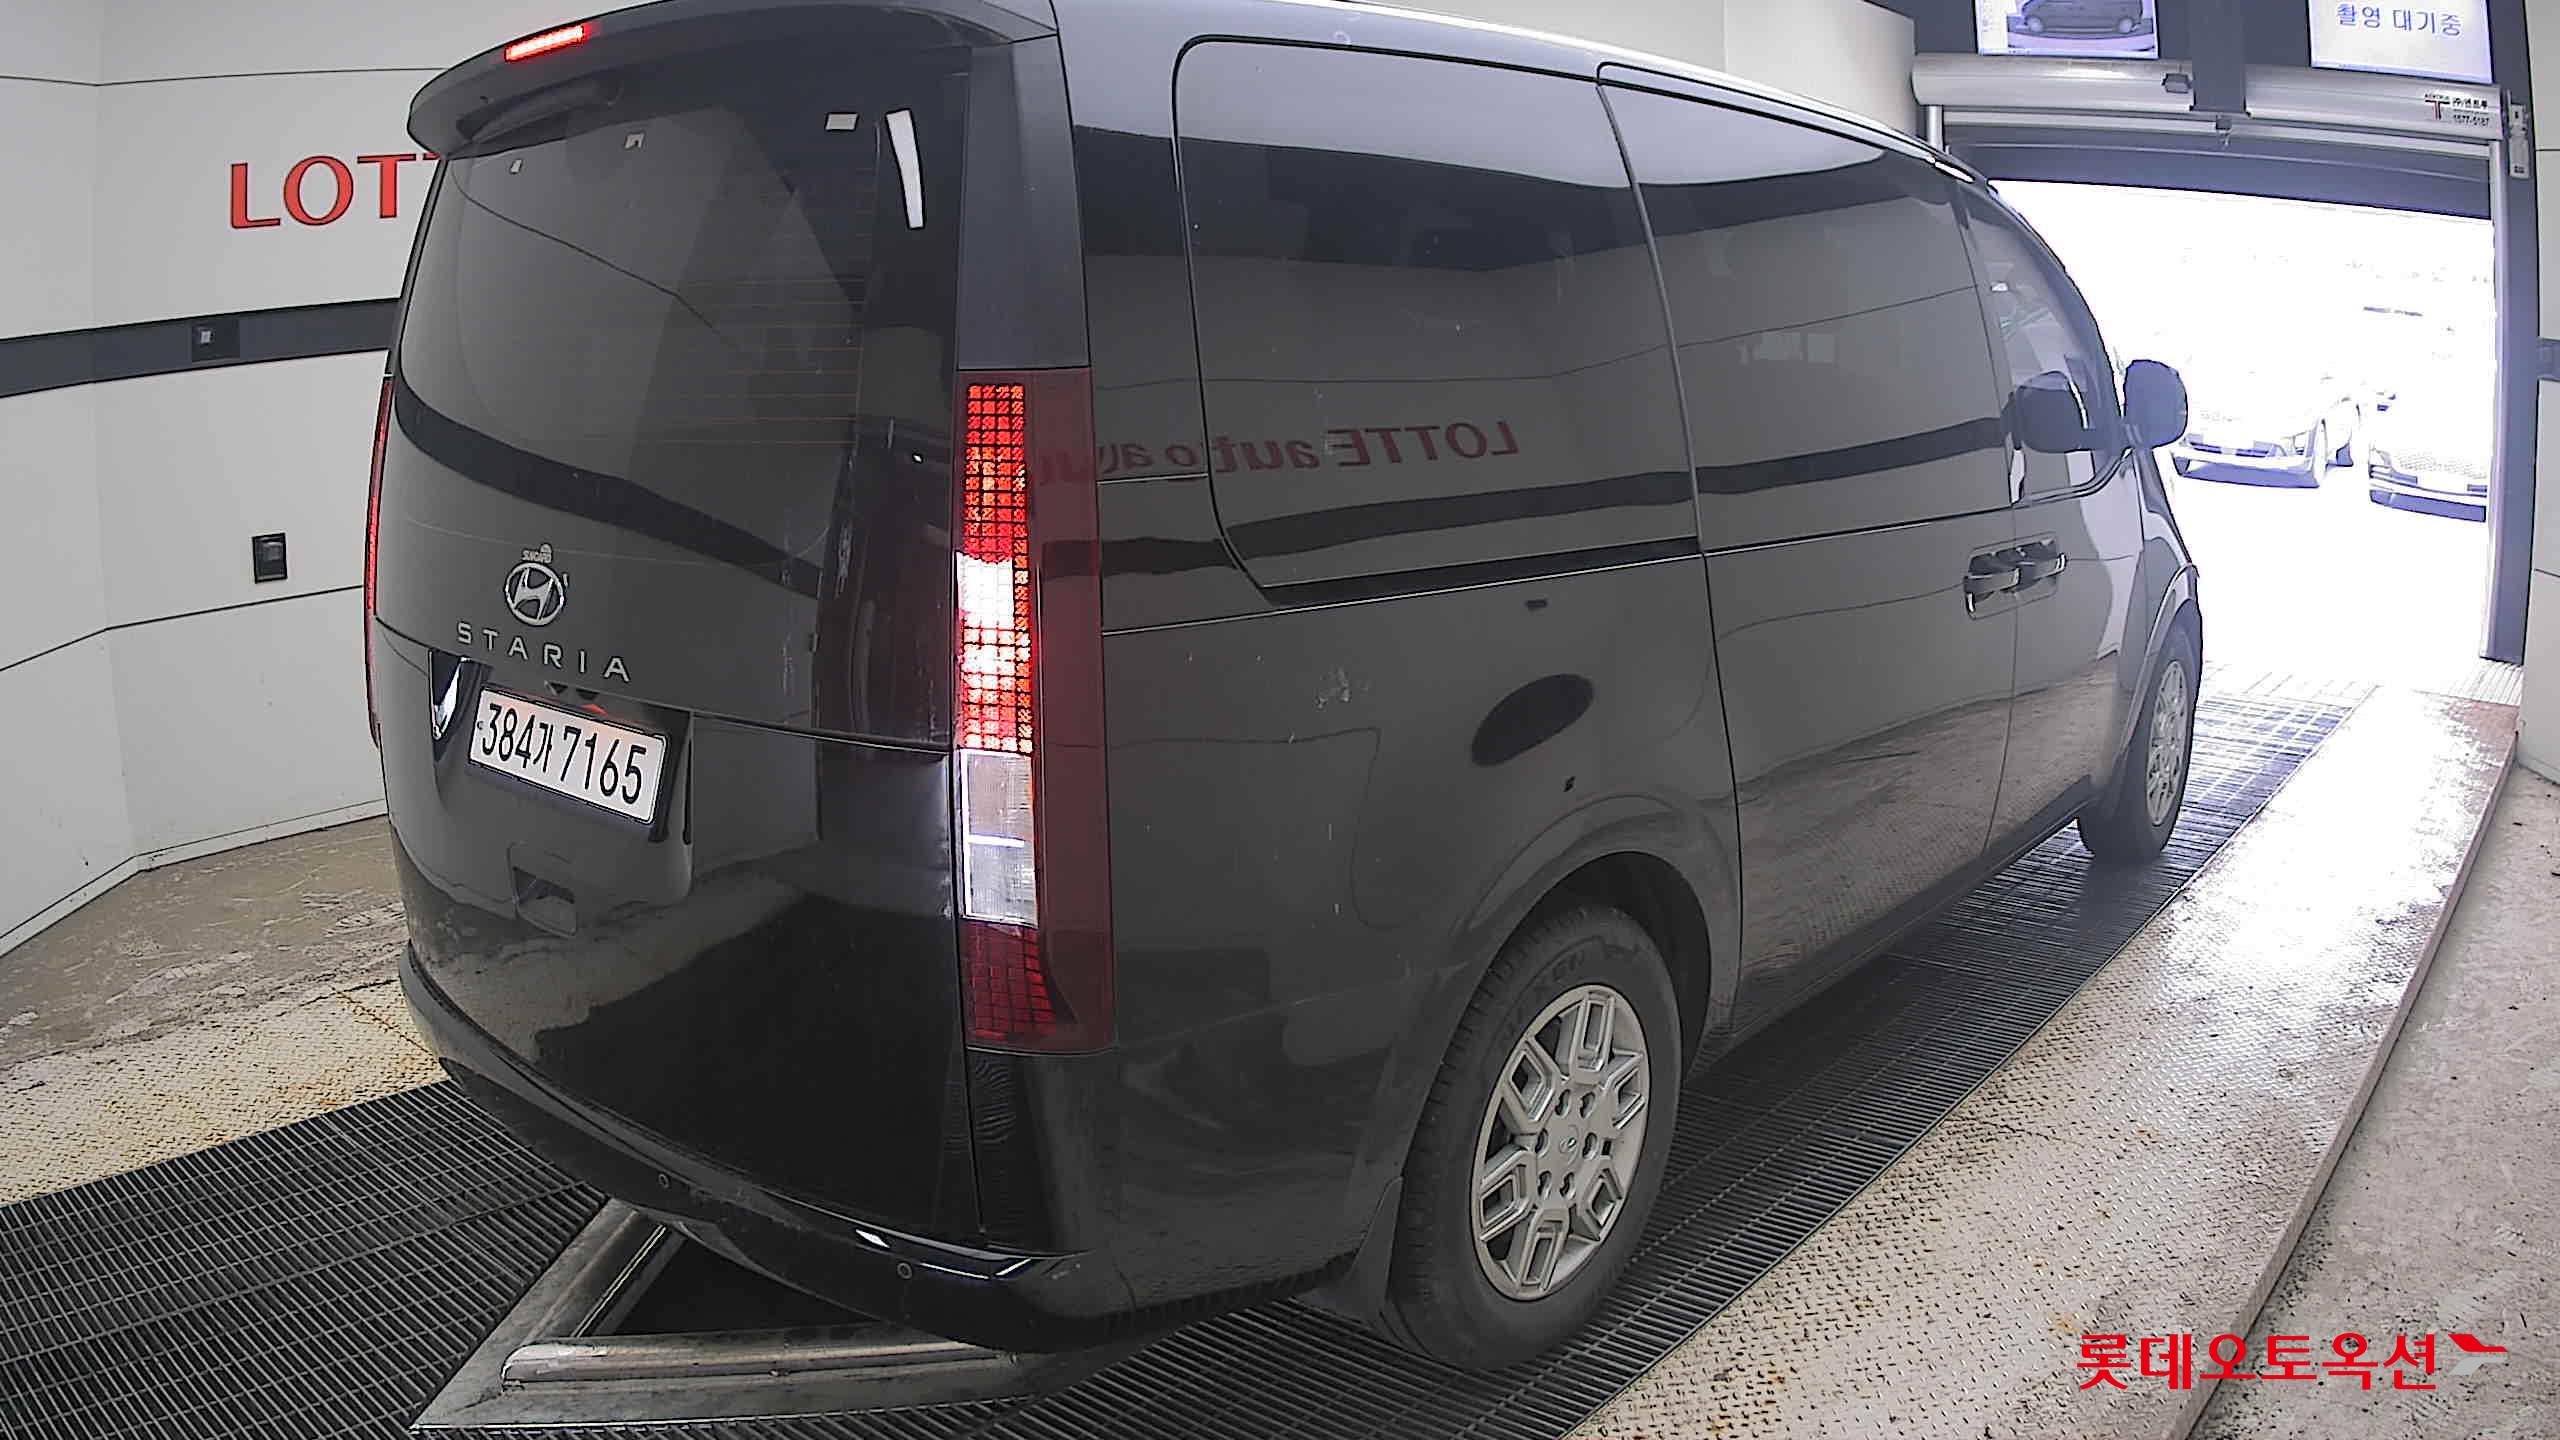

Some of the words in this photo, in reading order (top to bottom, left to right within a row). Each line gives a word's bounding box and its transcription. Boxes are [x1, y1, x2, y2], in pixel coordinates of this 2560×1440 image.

[2337, 4, 2381, 28] 촬영
[2392, 9, 2461, 37] 대기중
[229, 153, 442, 229] LOT
[456, 621, 632, 683] STARIA
[481, 702, 554, 773] 384가
[560, 725, 647, 805] 7165
